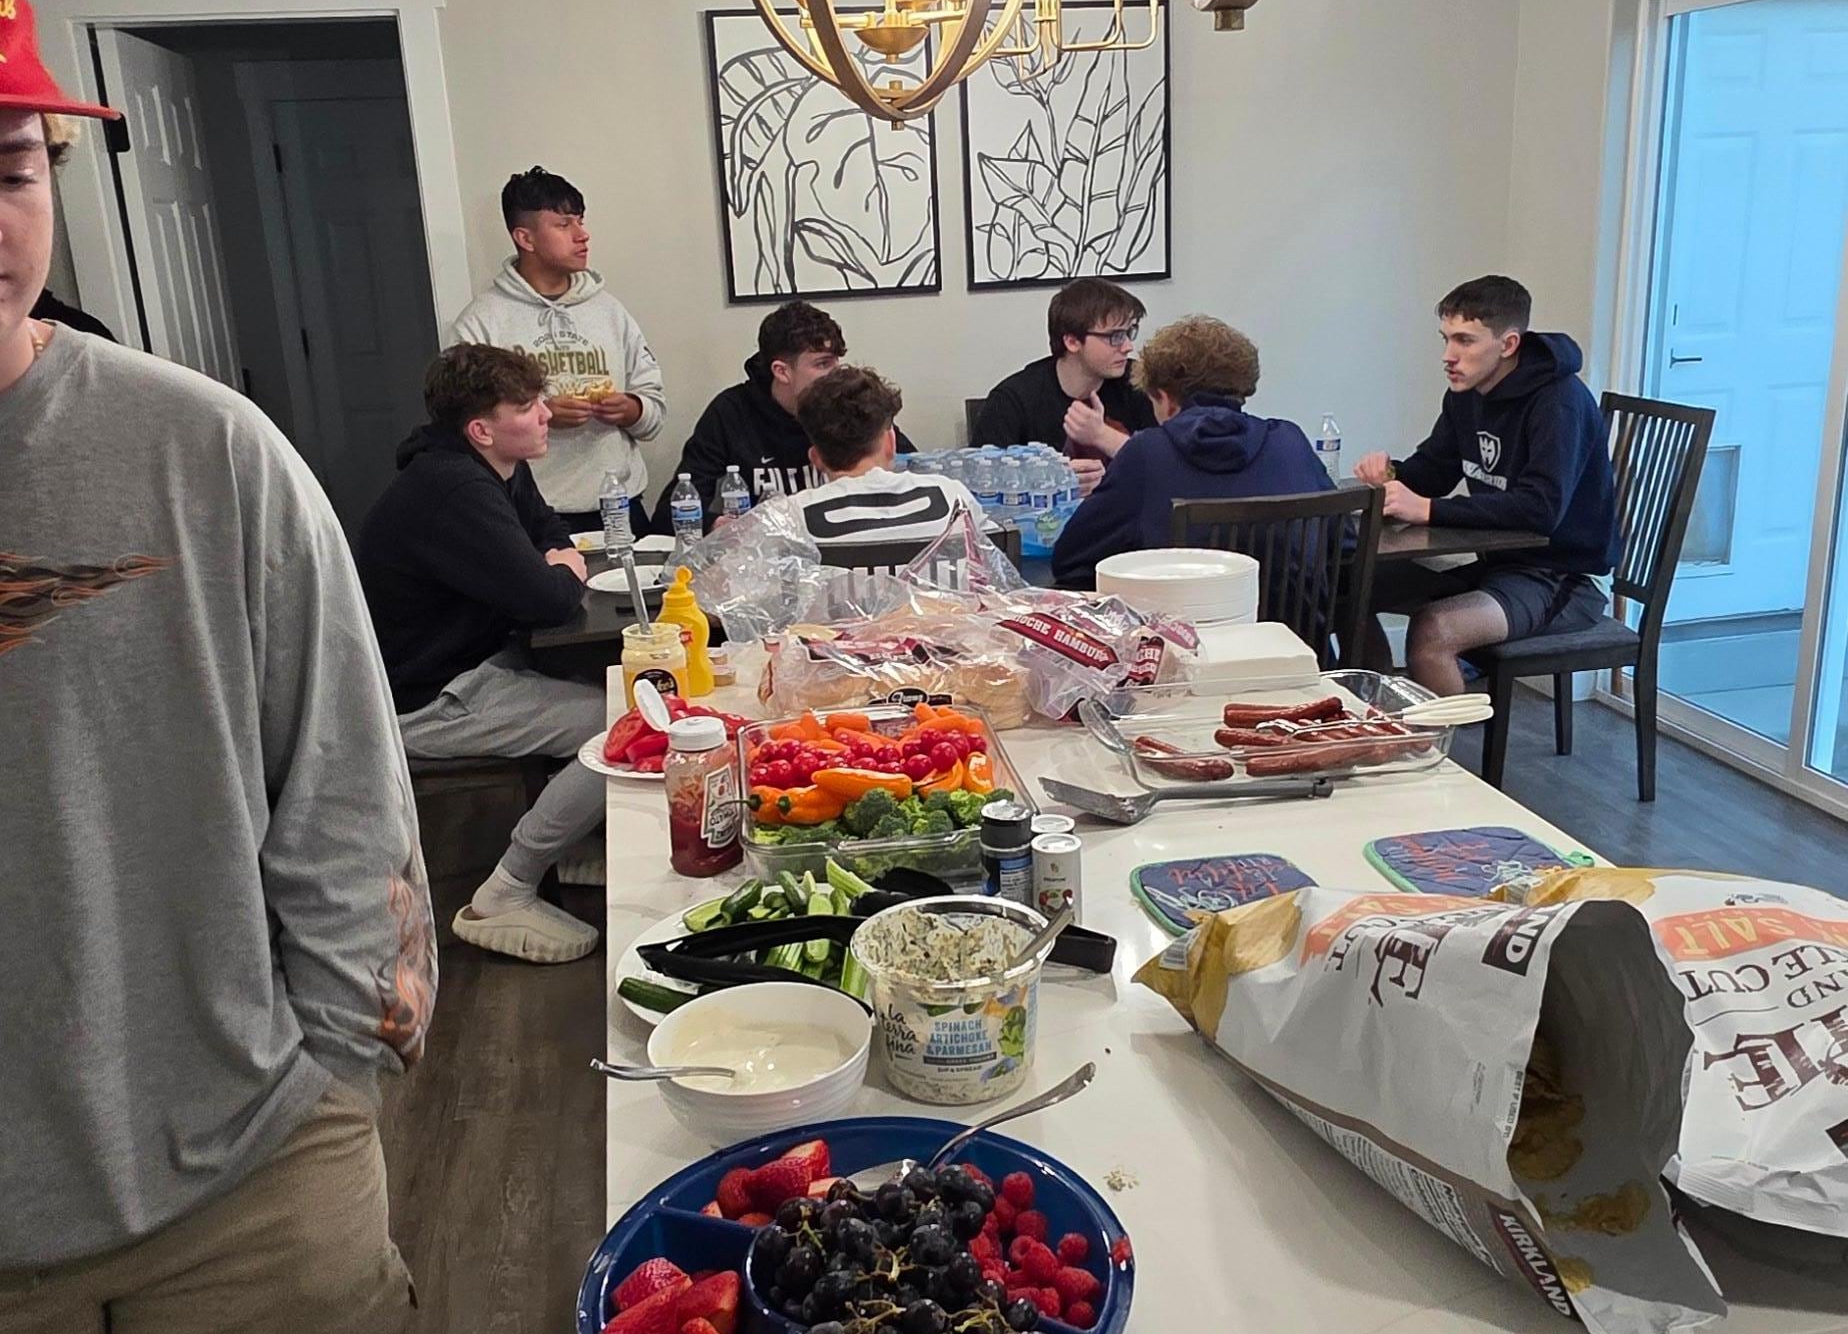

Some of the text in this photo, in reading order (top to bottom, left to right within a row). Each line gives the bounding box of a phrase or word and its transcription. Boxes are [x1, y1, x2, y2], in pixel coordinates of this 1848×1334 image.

[1674, 915, 1797, 957] SALT
[1678, 965, 1771, 1003] CUT
[929, 1029, 988, 1045] ARTICHOKE
[934, 1018, 982, 1033] SPINACH
[1500, 1213, 1571, 1318] KIRKLAND
